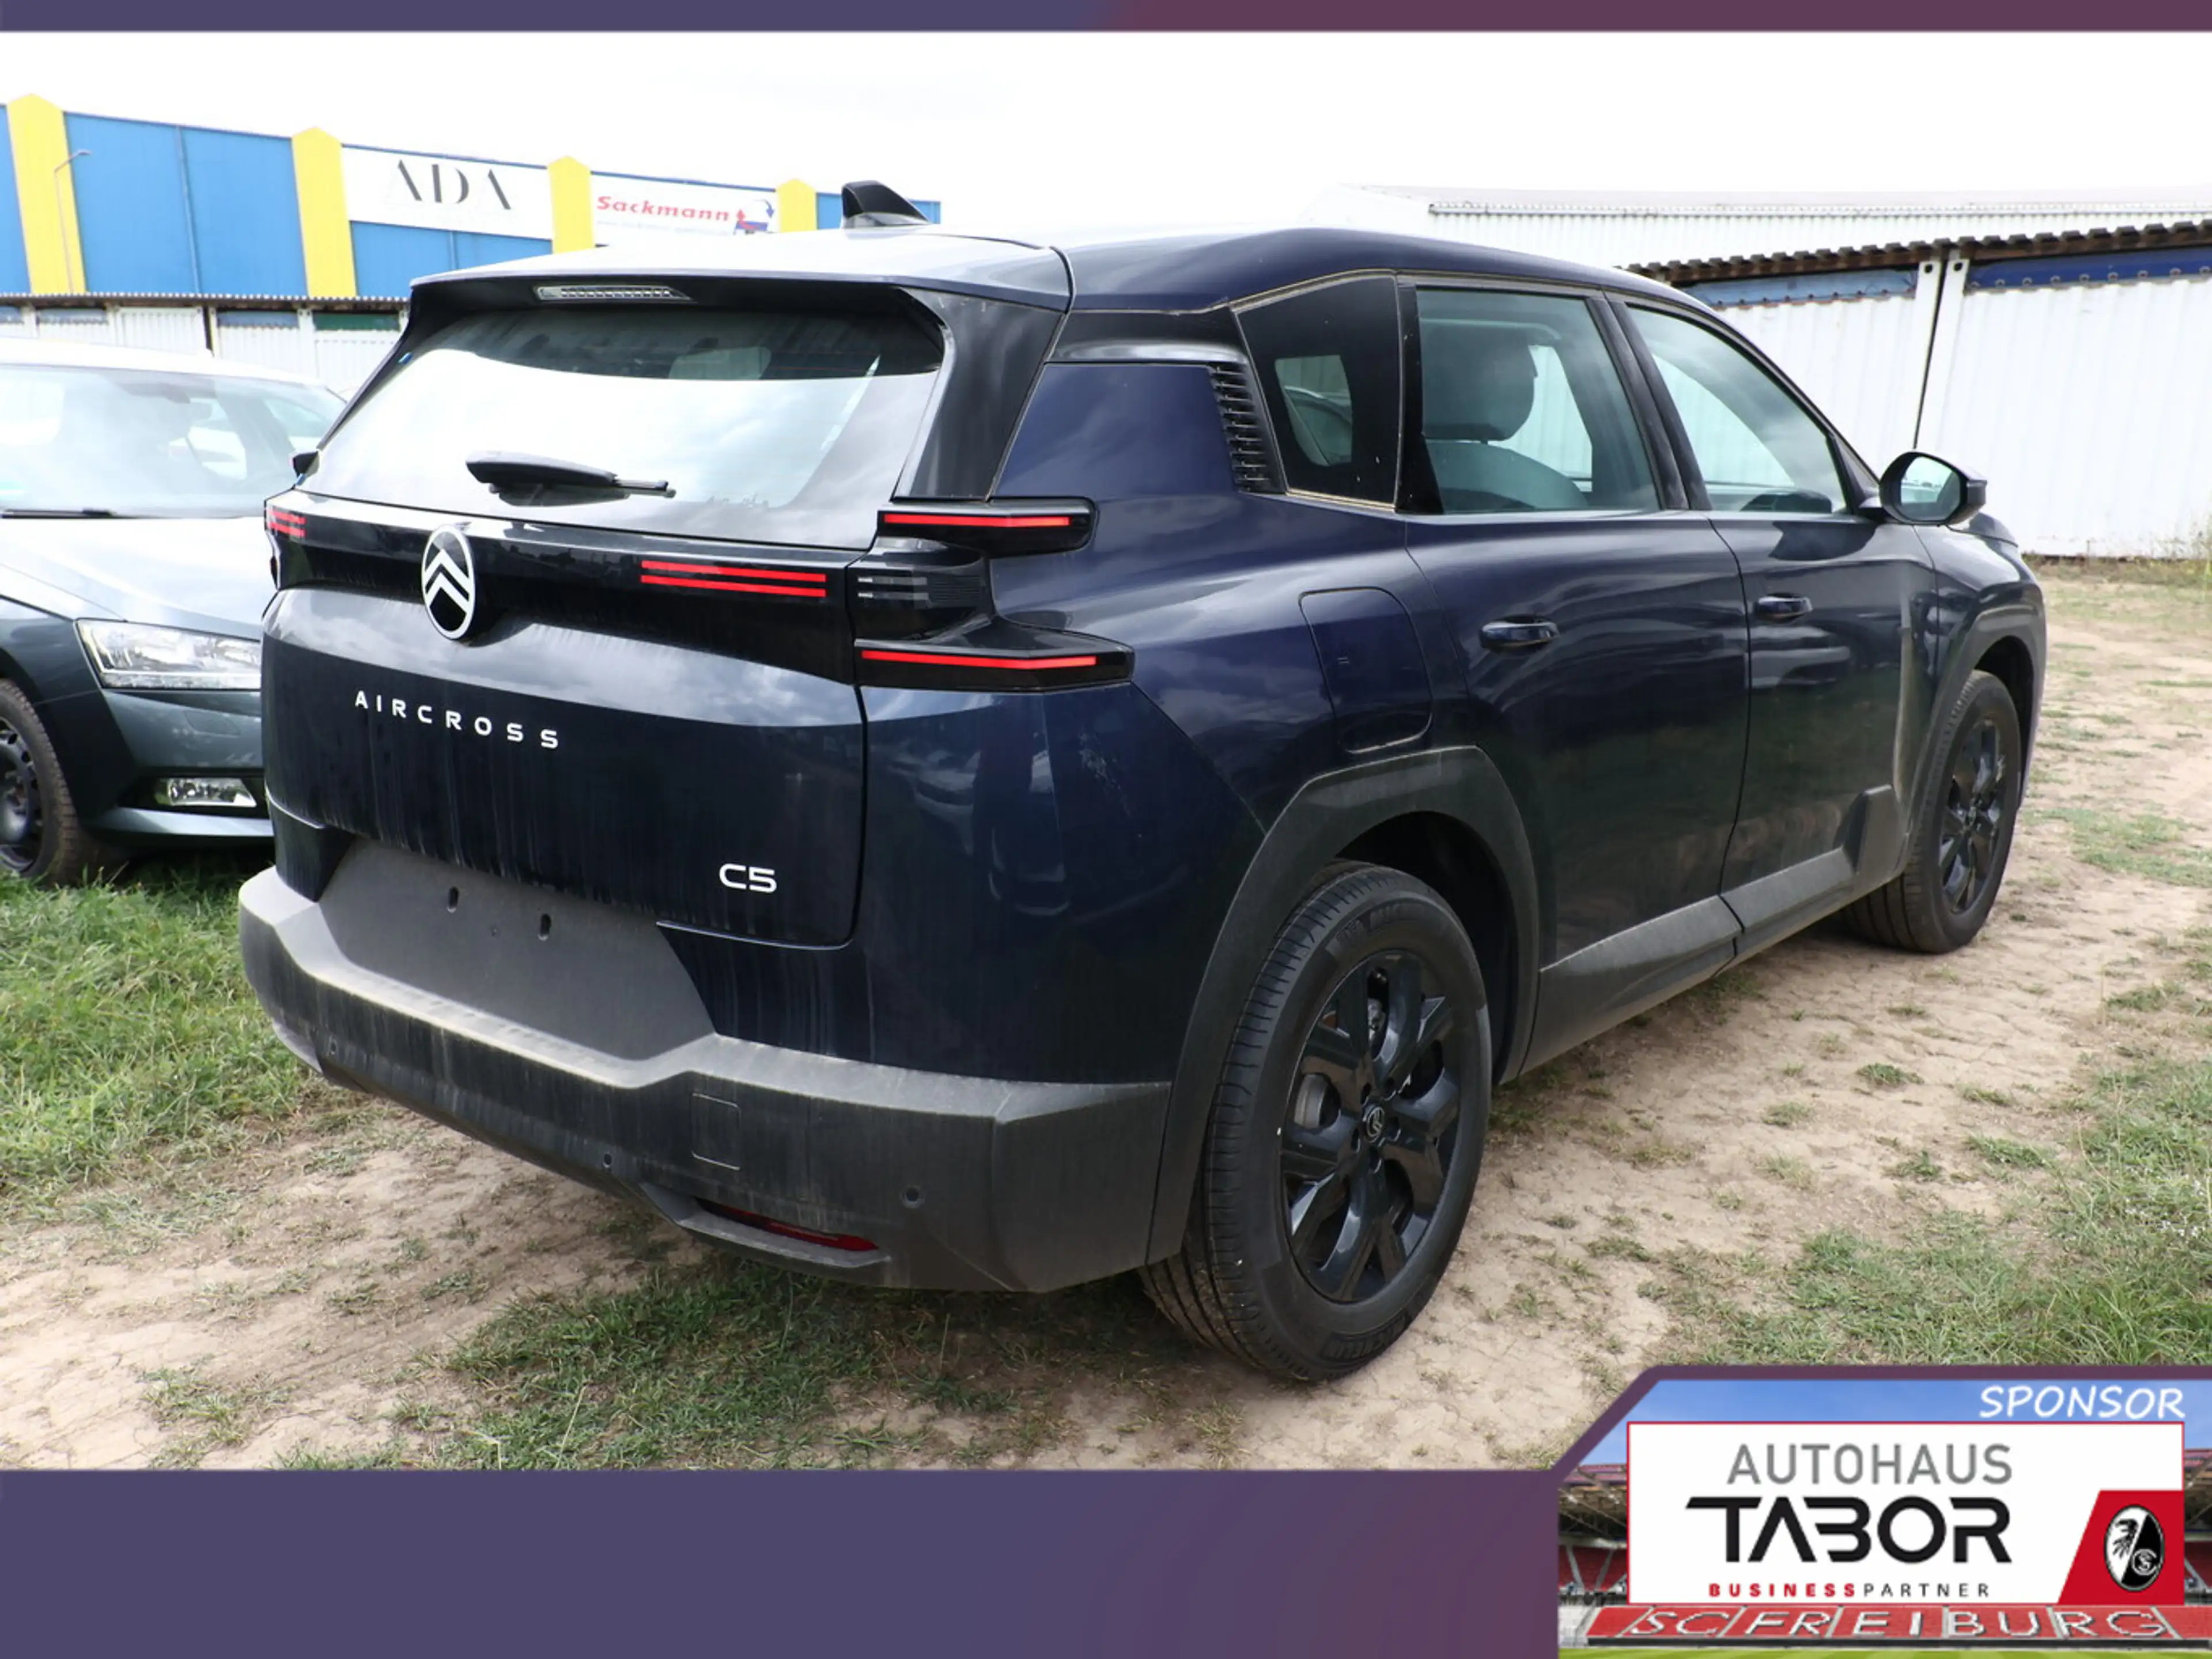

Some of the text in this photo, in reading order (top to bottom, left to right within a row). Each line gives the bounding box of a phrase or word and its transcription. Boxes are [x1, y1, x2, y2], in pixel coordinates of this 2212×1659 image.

[392, 158, 512, 210] ADA
[596, 195, 729, 222] Sackmann
[354, 690, 559, 749] AIRCROSS
[719, 863, 777, 893] C5
